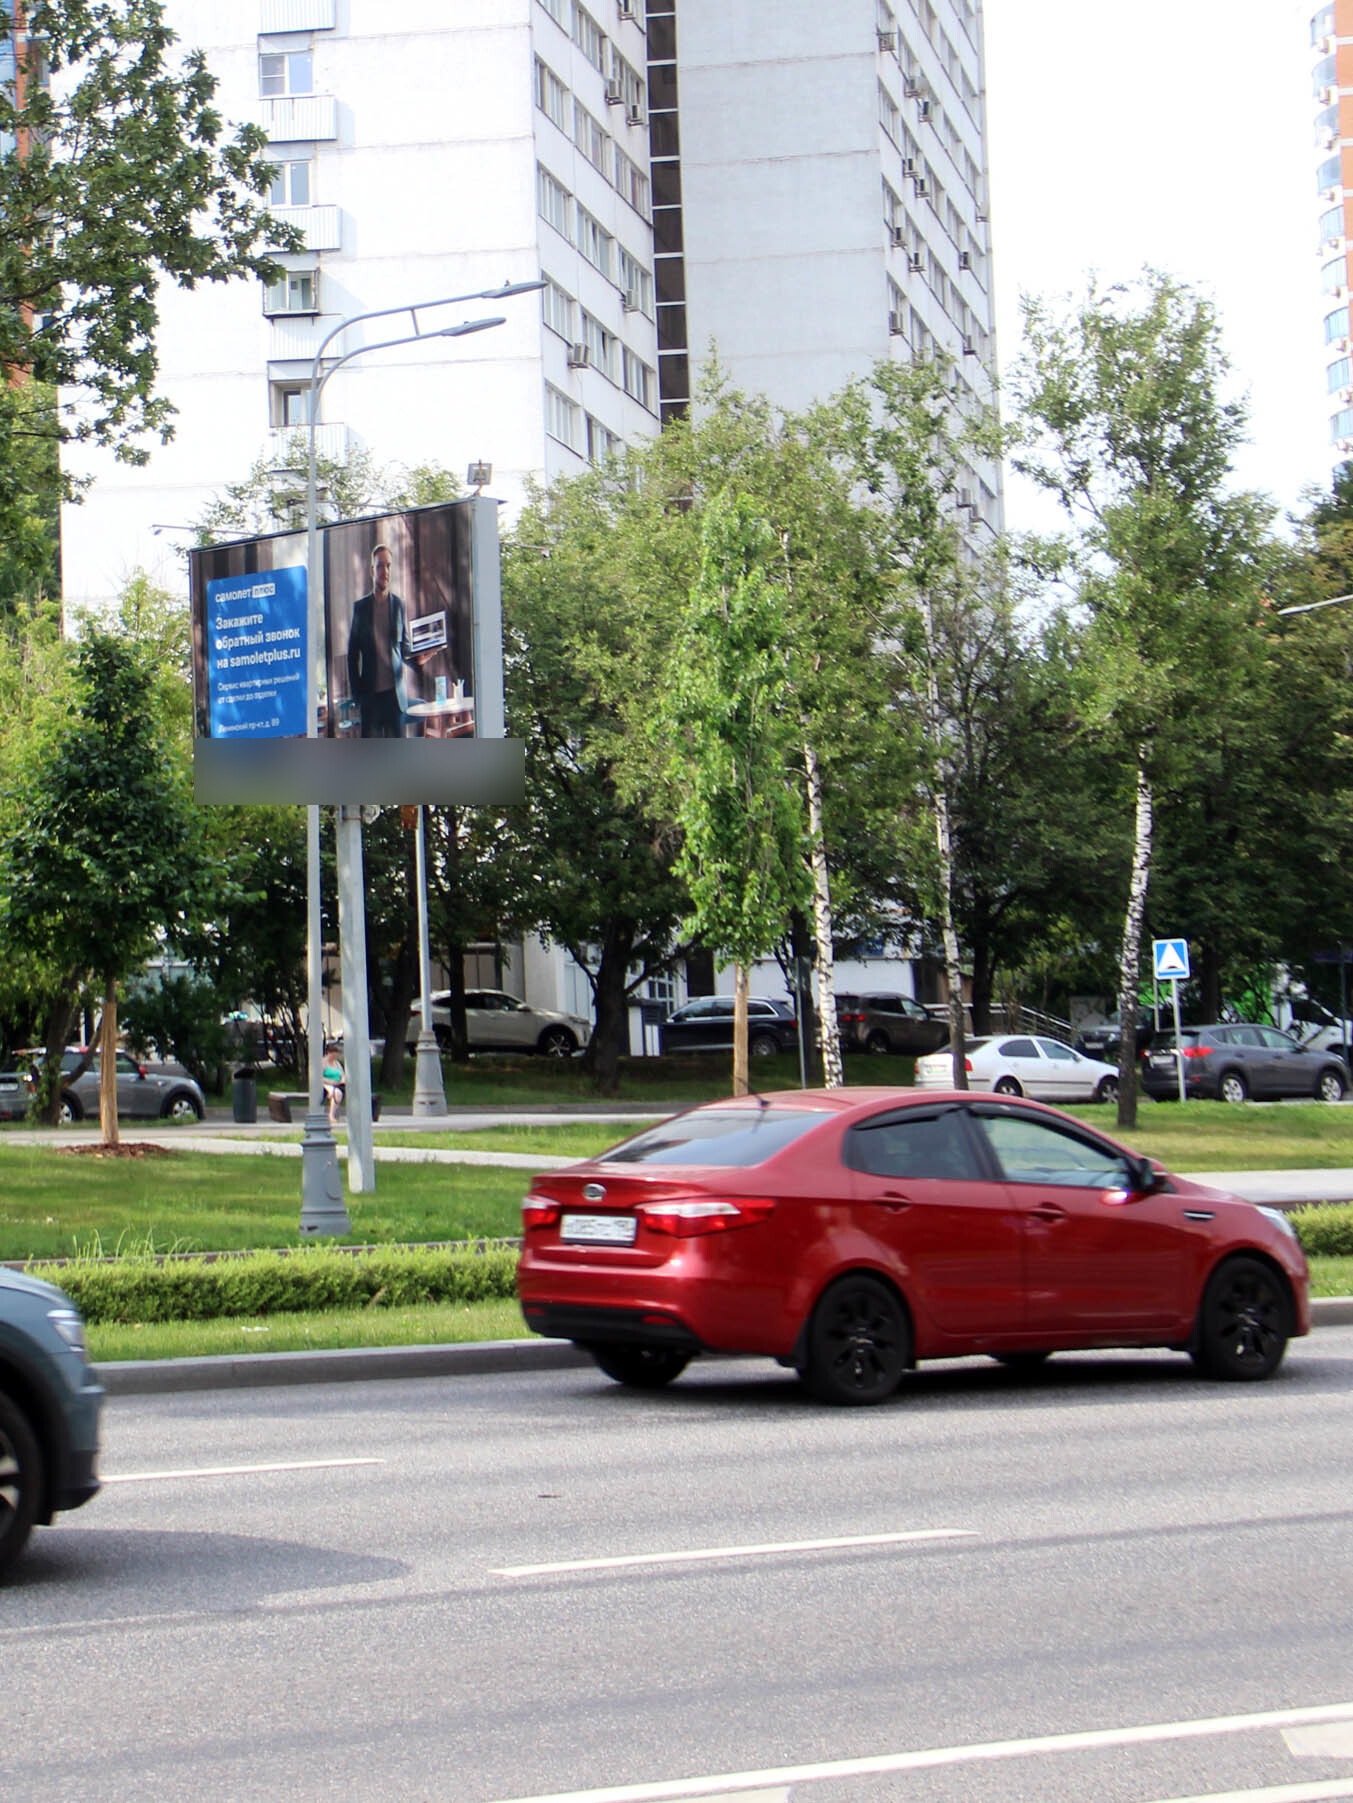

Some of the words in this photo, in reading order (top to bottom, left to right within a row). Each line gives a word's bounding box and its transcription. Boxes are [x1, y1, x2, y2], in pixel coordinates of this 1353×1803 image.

[215, 614, 264, 630] Закажите
[215, 631, 264, 651] обратный
[265, 628, 301, 642] звонок
[216, 658, 229, 669] на
[230, 648, 301, 667] samoletplus.ru
